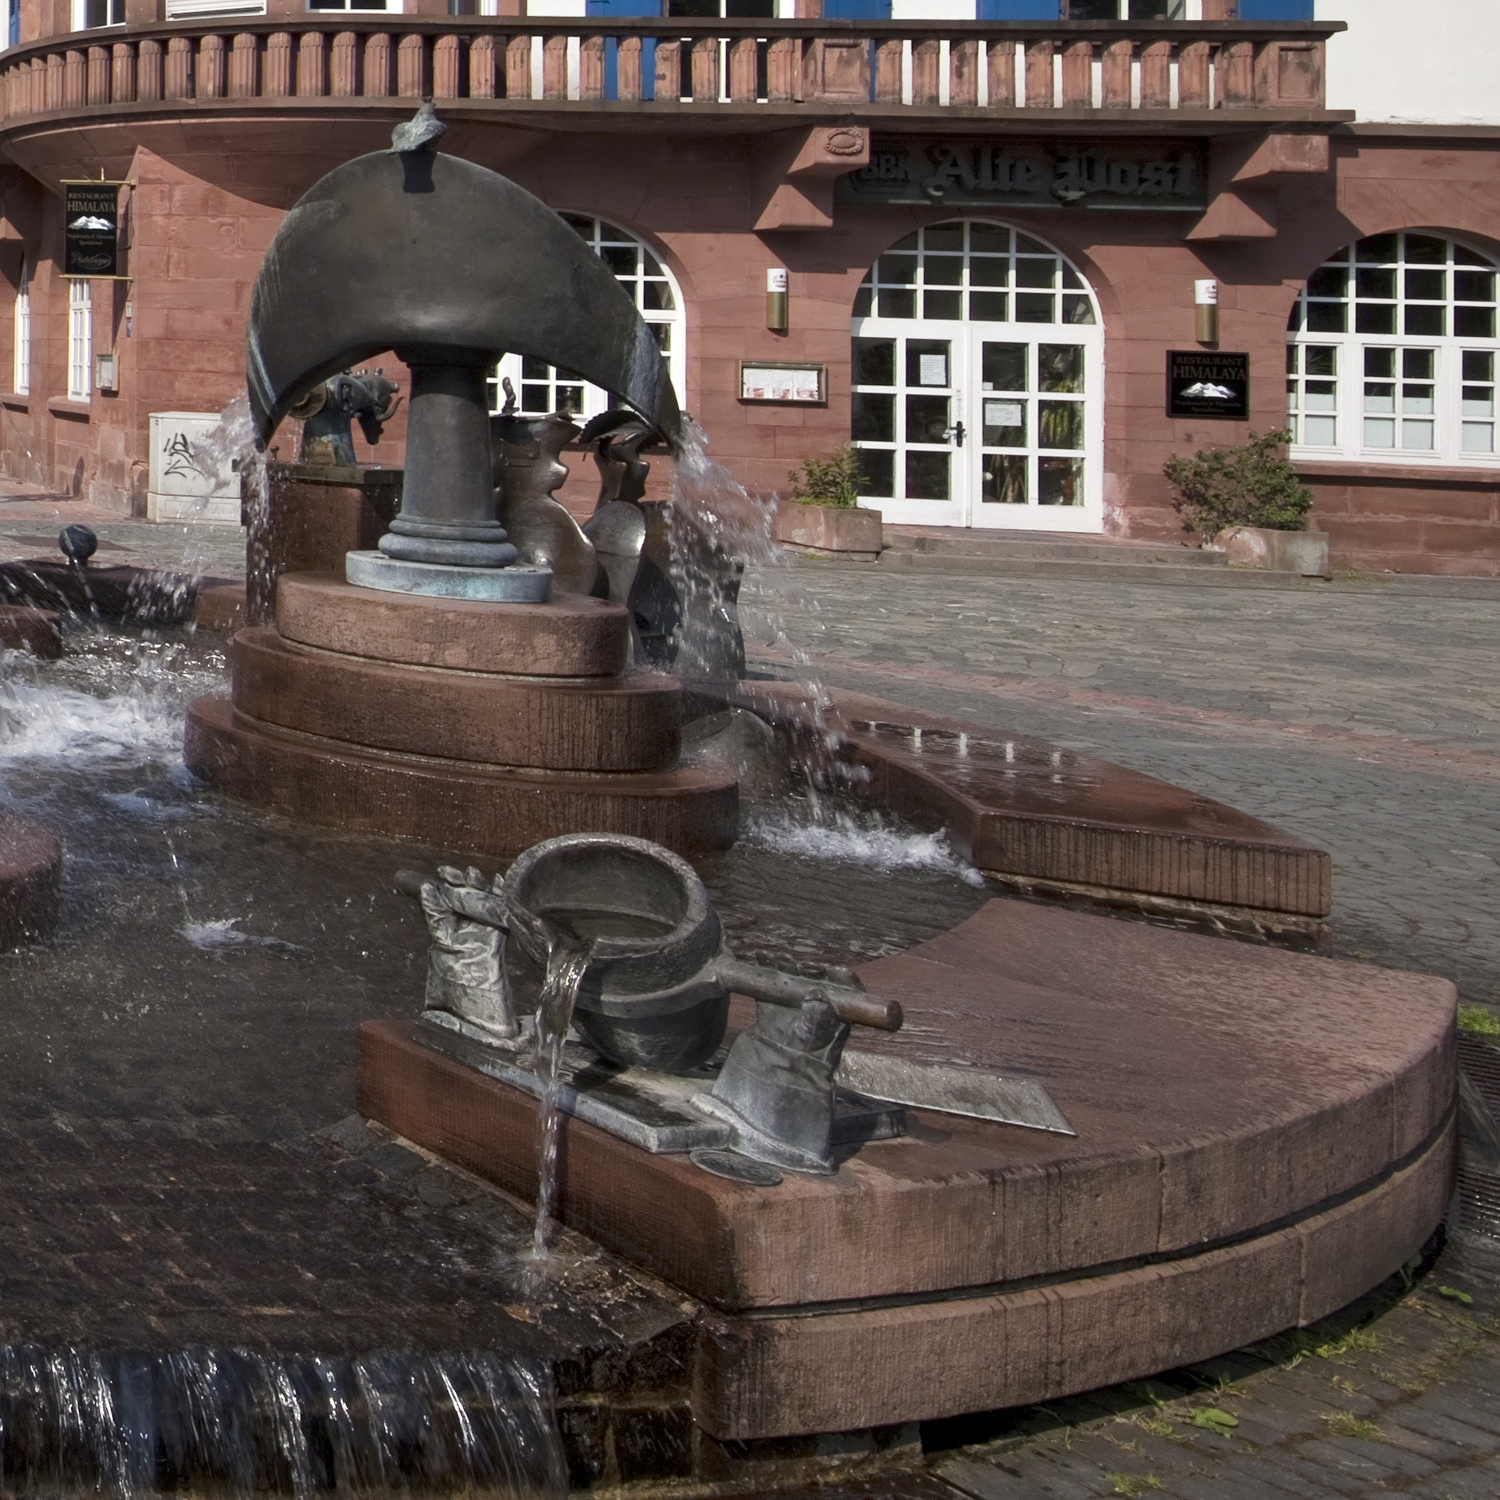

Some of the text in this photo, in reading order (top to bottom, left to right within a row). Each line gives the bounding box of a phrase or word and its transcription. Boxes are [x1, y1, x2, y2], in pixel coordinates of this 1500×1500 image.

[921, 144, 1043, 196] Alte
[68, 192, 115, 200] RESTAURANT
[67, 201, 116, 213] HIMALAYA
[1176, 356, 1243, 365] RESTAURANT
[1172, 365, 1246, 380] HIMALAYA
